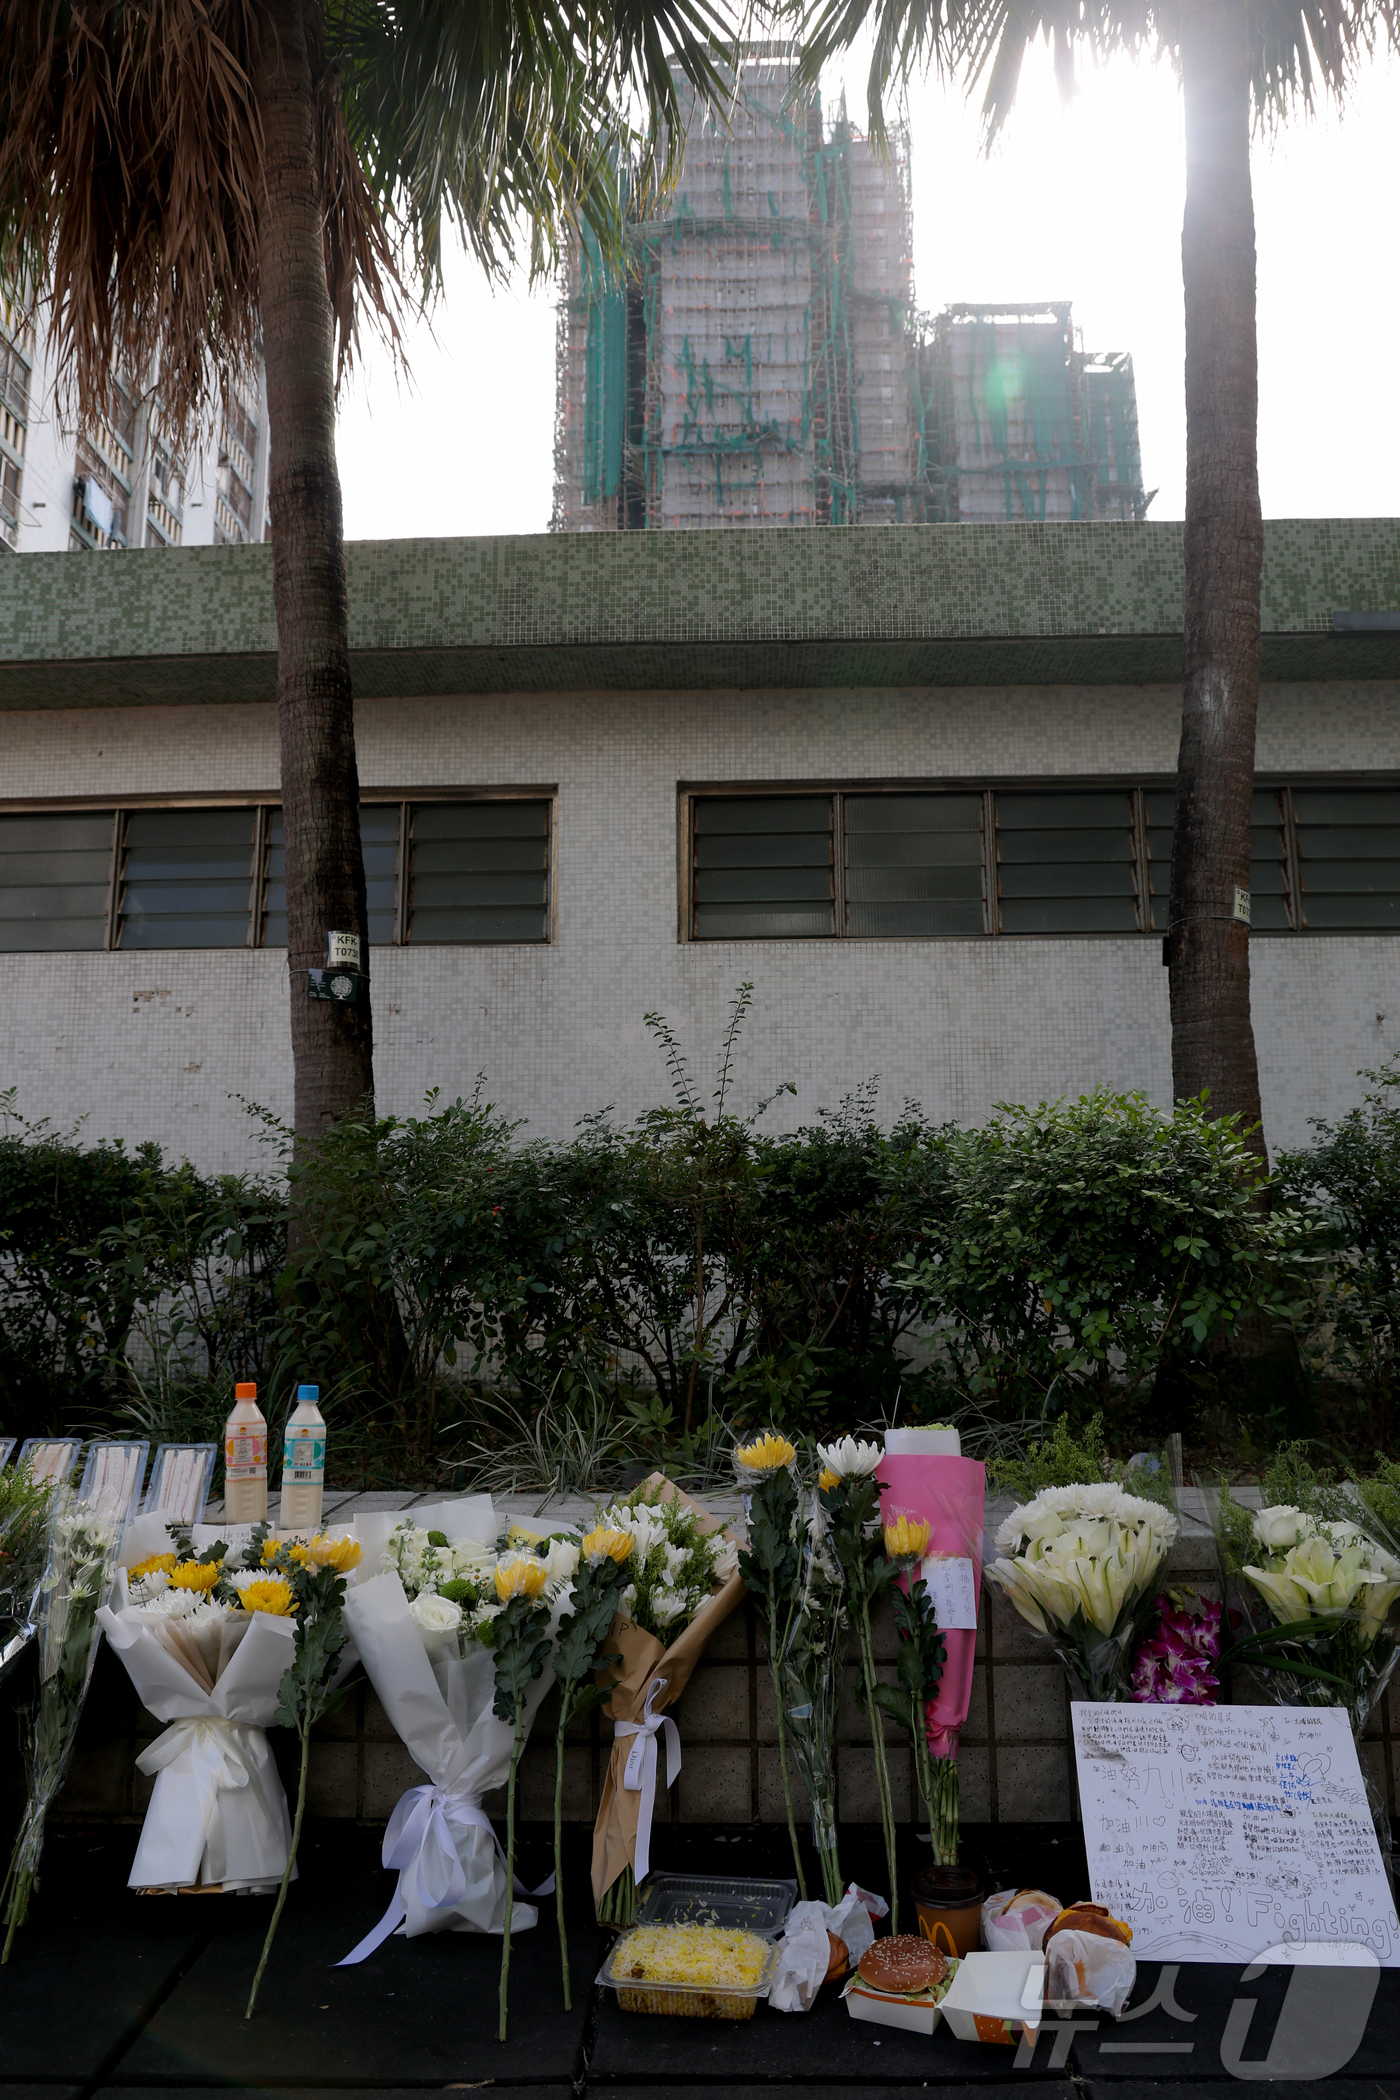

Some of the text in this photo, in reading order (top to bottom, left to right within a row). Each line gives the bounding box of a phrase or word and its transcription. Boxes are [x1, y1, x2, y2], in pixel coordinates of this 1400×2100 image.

[1240, 893, 1251, 903] KF
[608, 1621, 630, 1637] IP
[628, 1750, 639, 1771] Dior
[1093, 1763, 1188, 1802] 加油努力!!
[1099, 1814, 1149, 1834] 加油!!!
[1123, 1858, 1146, 1869] 加油
[1131, 1883, 1400, 1960] 加油! Fighting!
